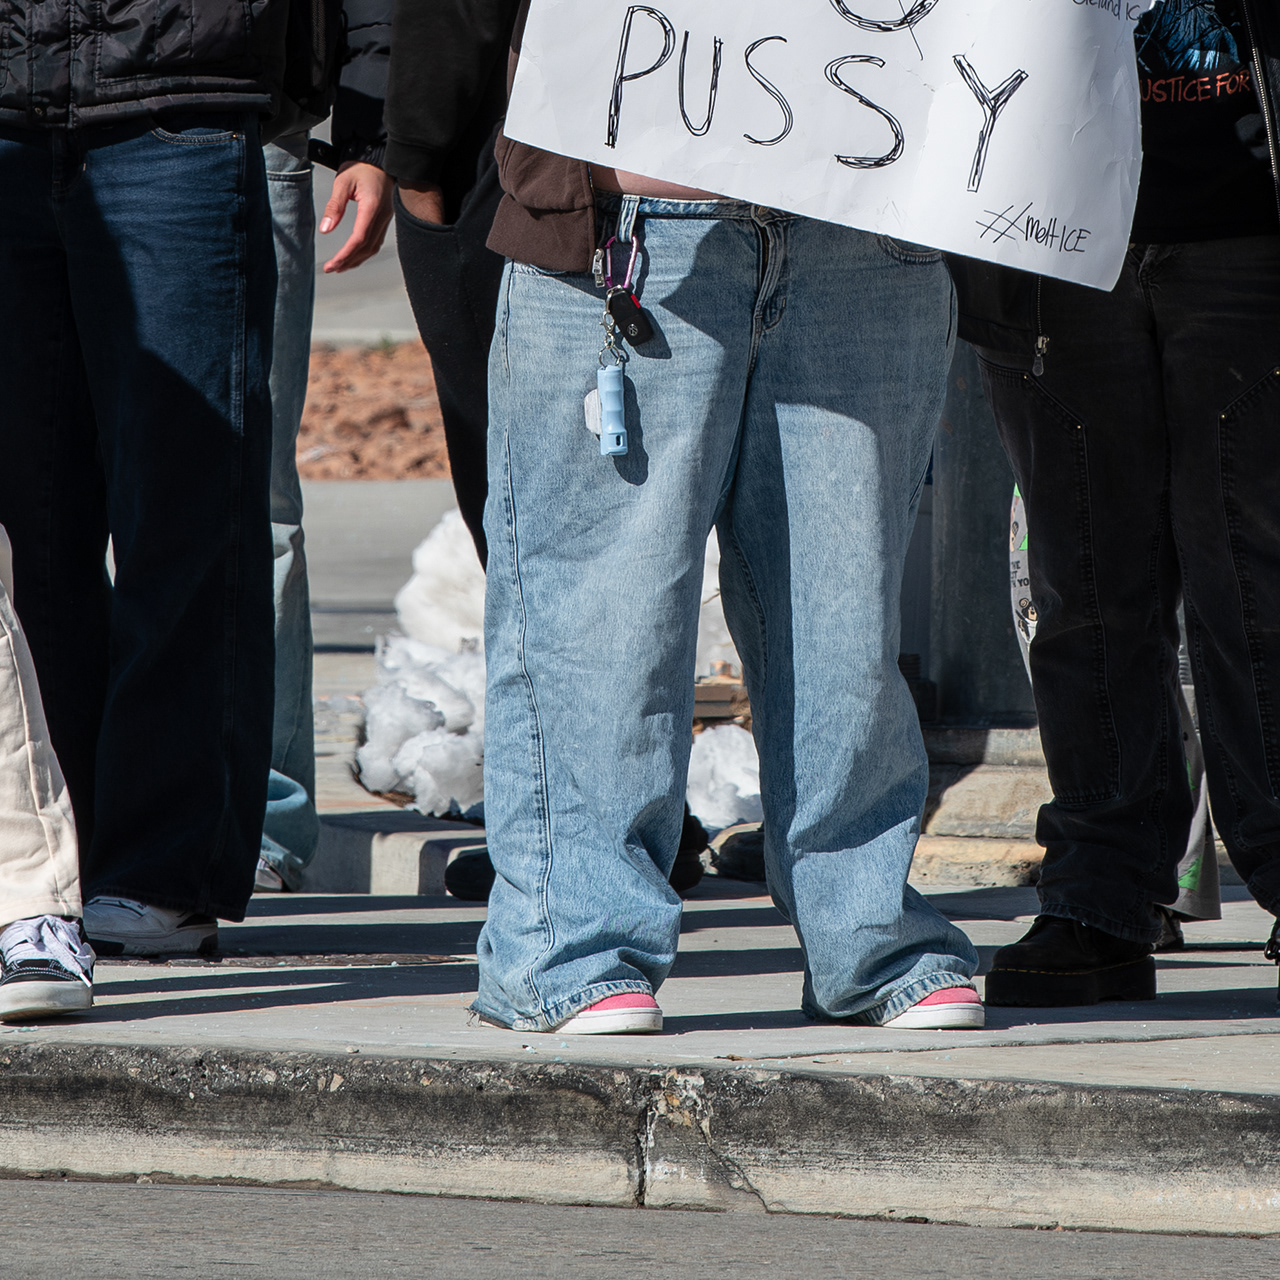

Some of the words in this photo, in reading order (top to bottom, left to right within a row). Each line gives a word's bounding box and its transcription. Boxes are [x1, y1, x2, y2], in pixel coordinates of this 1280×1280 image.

[605, 5, 1029, 193] PUSSY
[1140, 77, 1211, 103] USTICE
[1216, 71, 1250, 97] FOR
